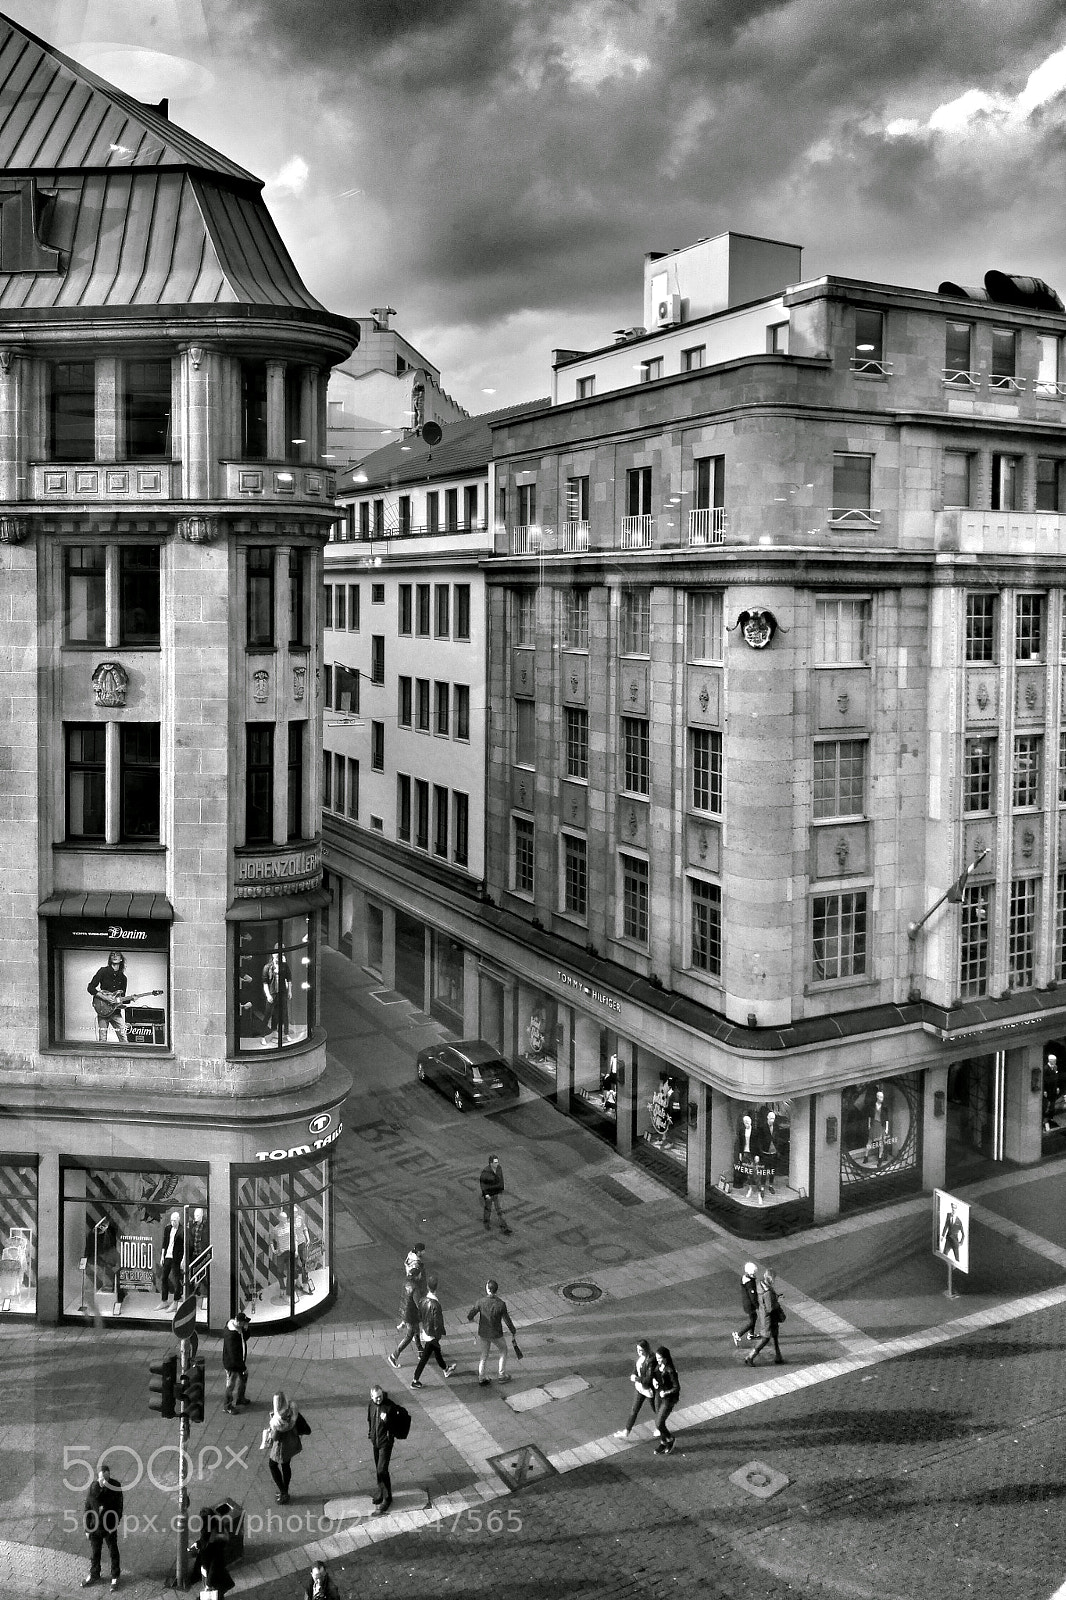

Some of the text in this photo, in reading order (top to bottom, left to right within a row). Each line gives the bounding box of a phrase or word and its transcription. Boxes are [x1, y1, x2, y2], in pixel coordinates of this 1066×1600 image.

[108, 925, 148, 940] Denim
[557, 970, 621, 1013] TOMMY HILFIGER
[124, 1022, 154, 1036] Denim
[255, 1144, 312, 1161] TOM
[733, 1163, 753, 1174] WERE
[756, 1168, 776, 1176] HERE
[120, 1241, 153, 1270] INDIGO
